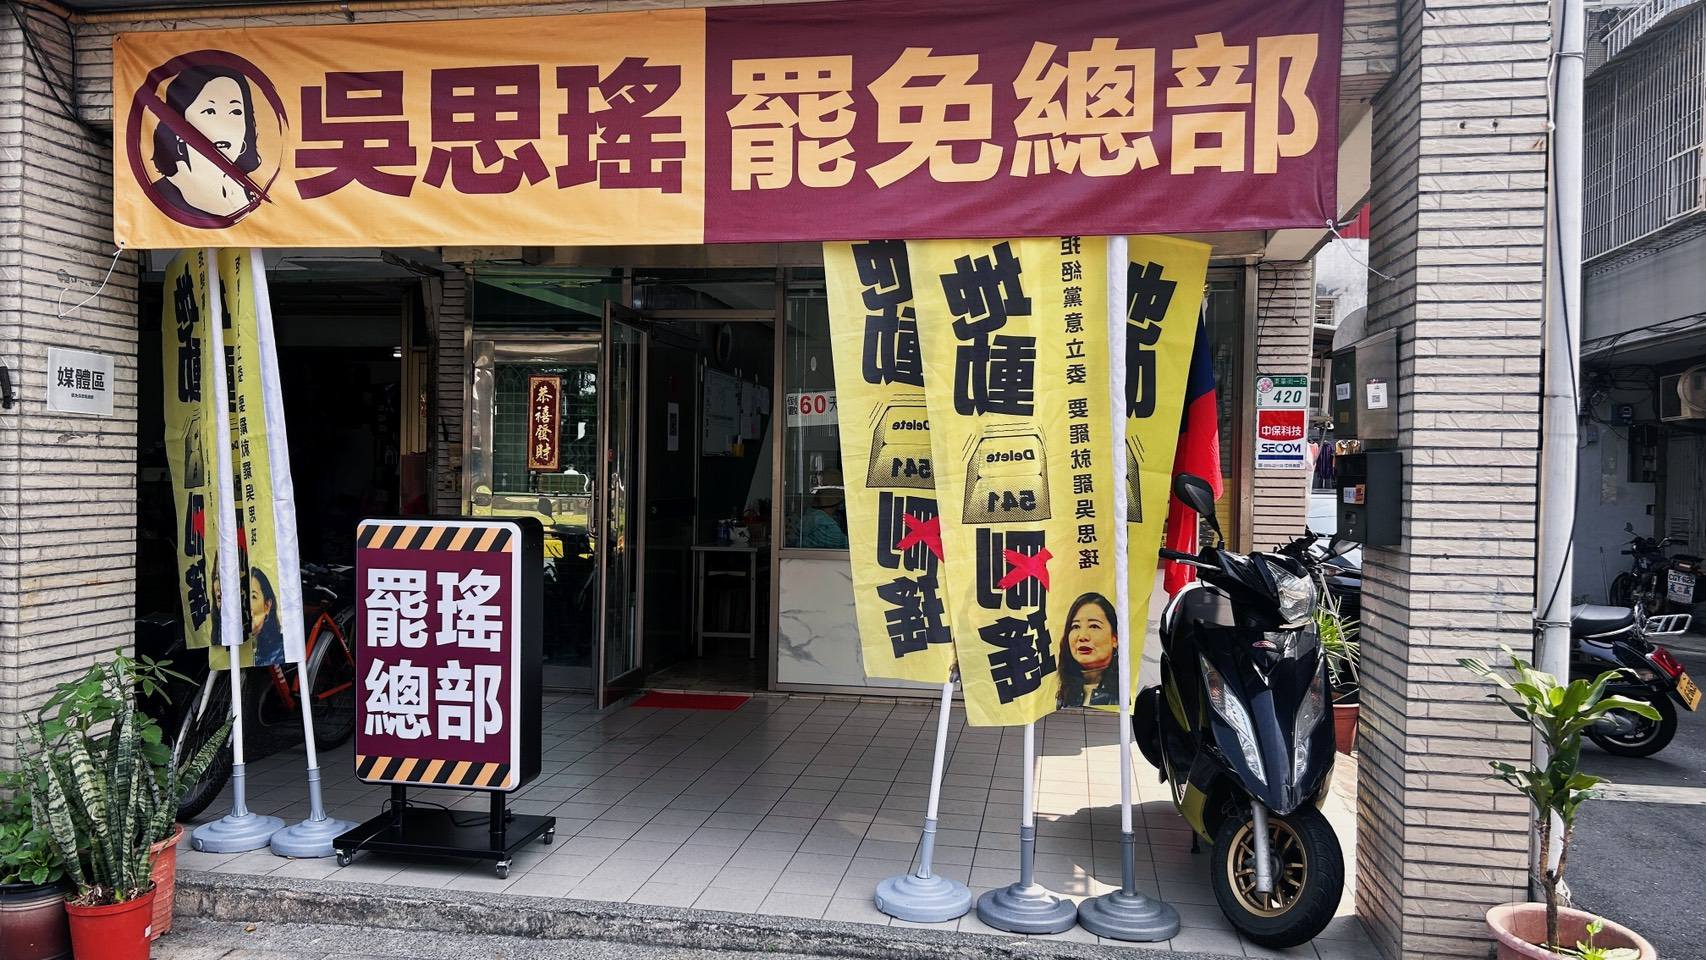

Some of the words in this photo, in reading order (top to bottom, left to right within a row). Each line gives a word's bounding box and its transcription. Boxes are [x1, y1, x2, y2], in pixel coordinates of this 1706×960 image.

[295, 57, 687, 200] 吳思瑤
[726, 31, 1320, 191] 罷免總部
[57, 366, 105, 391] 媒體區
[1273, 390, 1302, 403] 420
[535, 385, 553, 461] 恭禧發財
[1261, 425, 1302, 437] 中保科技
[1261, 443, 1301, 453] SECOM
[365, 568, 503, 652] 罷瑤
[364, 658, 503, 743] 總部
